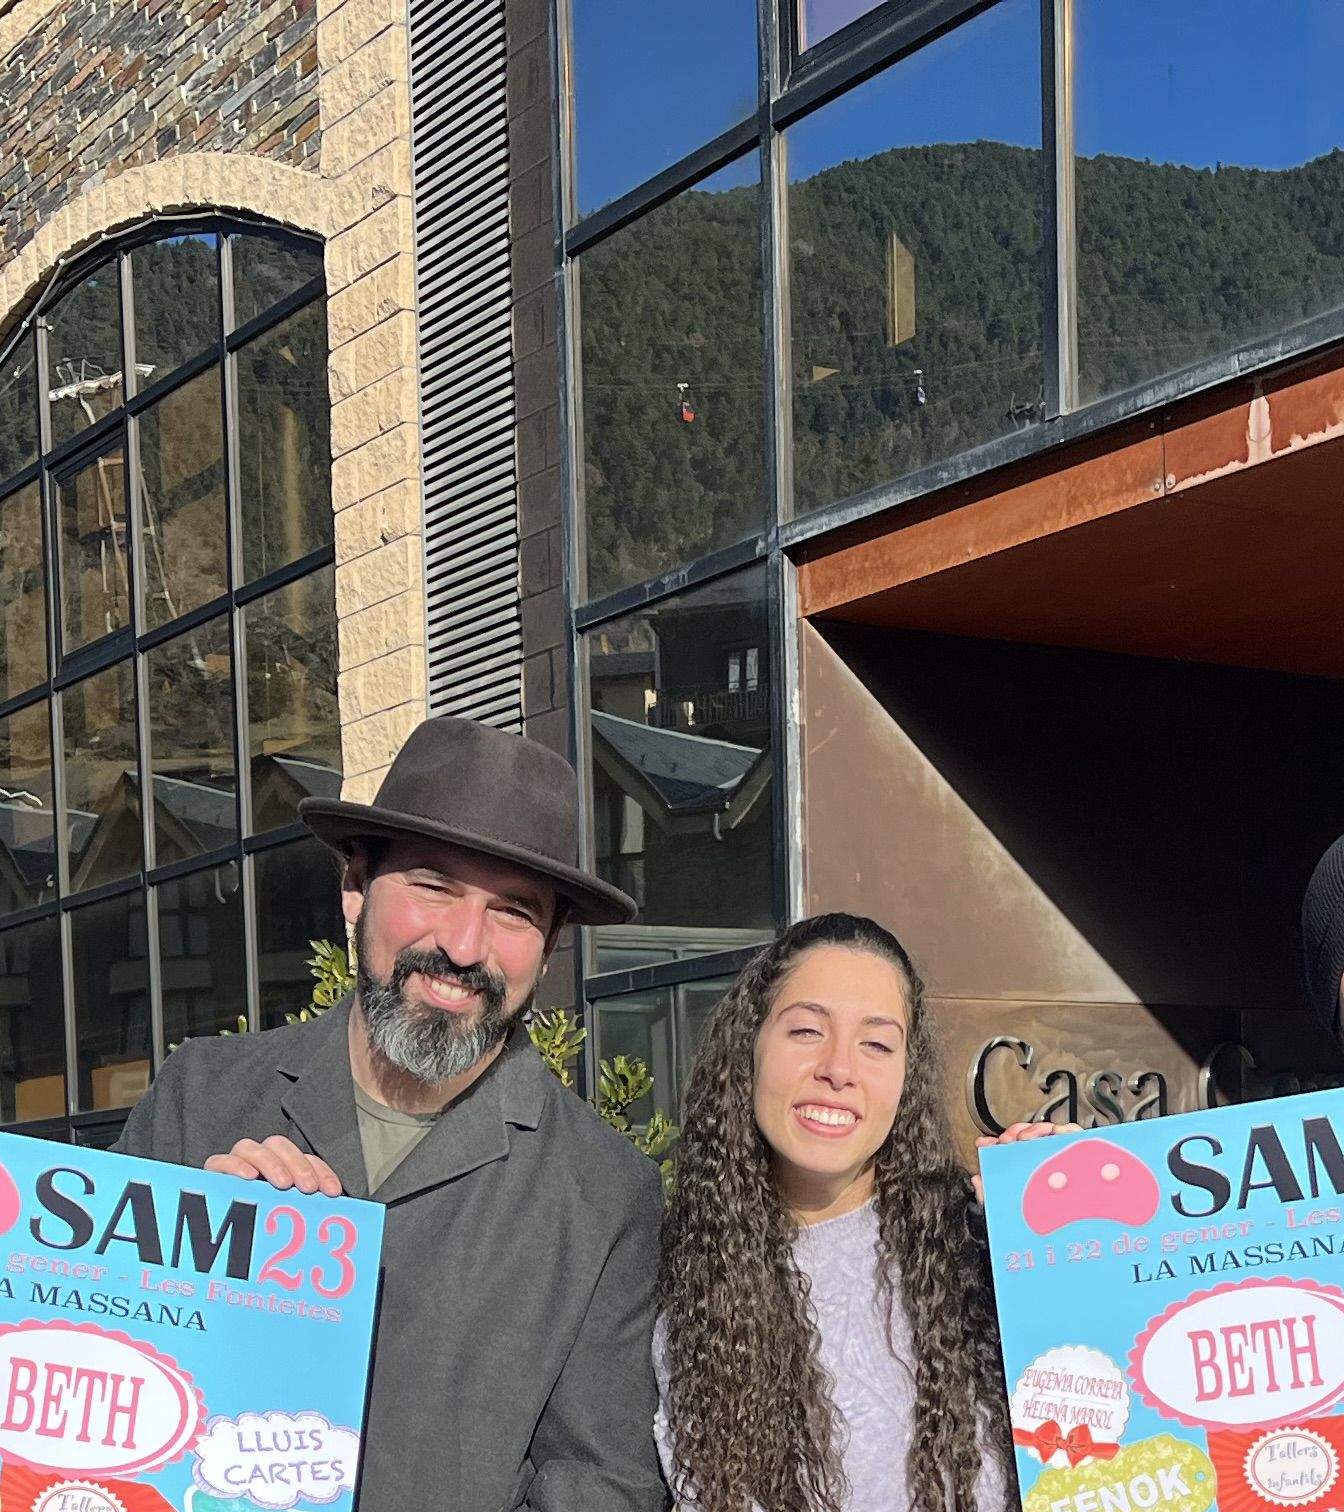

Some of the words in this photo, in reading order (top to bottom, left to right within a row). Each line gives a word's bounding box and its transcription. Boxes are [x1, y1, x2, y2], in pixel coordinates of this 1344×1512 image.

[966, 1035, 1167, 1137] Casa
[1003, 1248, 1034, 1273] 21
[1044, 1244, 1054, 1267] i
[1064, 1236, 1107, 1263] 22
[1111, 1229, 1148, 1256] de
[1158, 1217, 1254, 1254] gener
[1283, 1204, 1341, 1230] Les
[4, 1247, 108, 1285] gener
[138, 1268, 196, 1298] Les
[204, 1279, 343, 1324] Fontetes
[1131, 1258, 1175, 1284] LA
[28, 1280, 208, 1332] MASSANA
[1187, 1314, 1325, 1404] BETH
[0, 1356, 145, 1450] BETH
[237, 1429, 323, 1453] LLUIS
[1264, 1440, 1319, 1463] Tallers
[224, 1459, 344, 1485] CARTES
